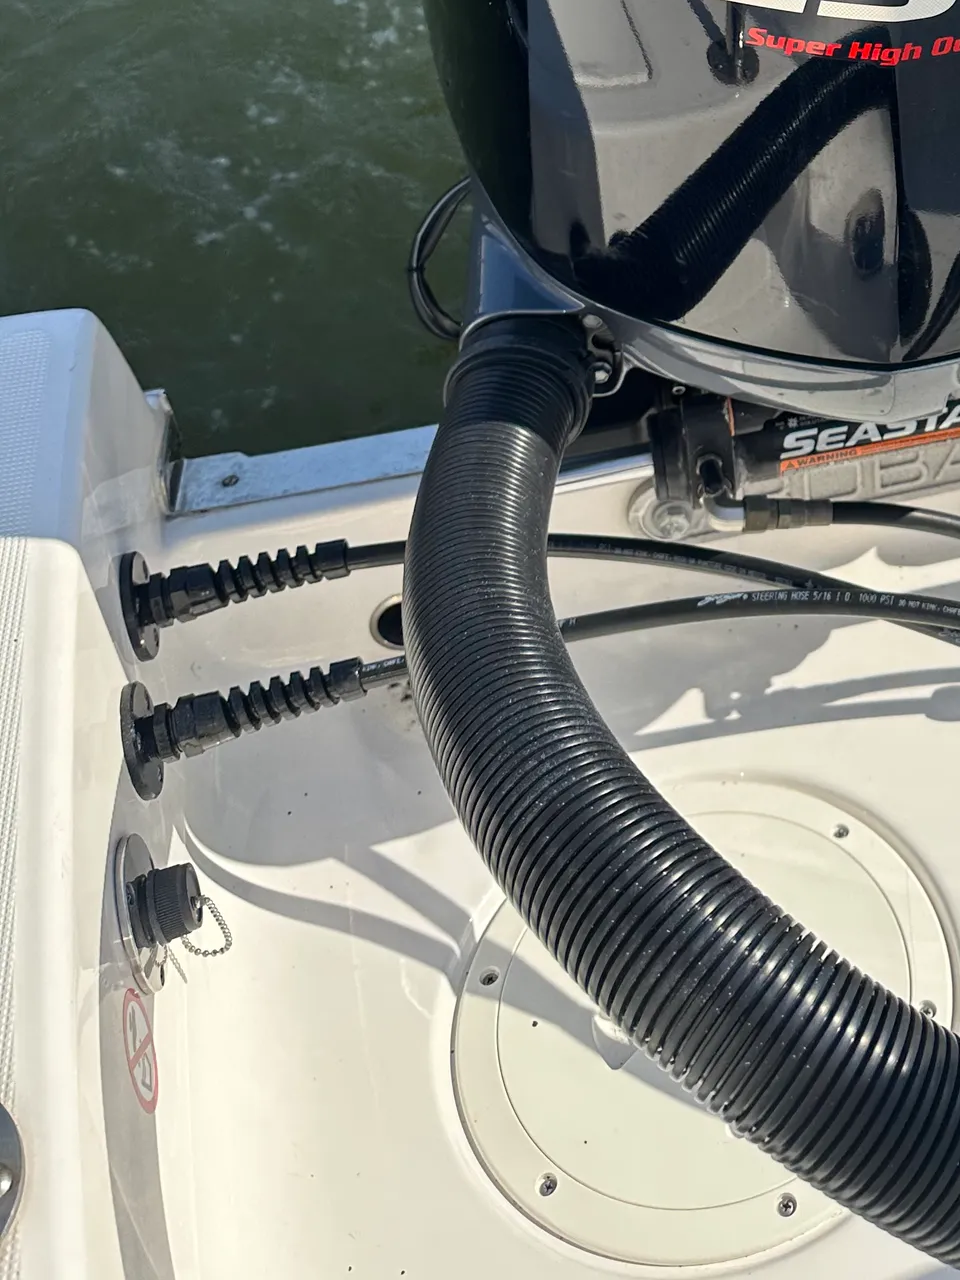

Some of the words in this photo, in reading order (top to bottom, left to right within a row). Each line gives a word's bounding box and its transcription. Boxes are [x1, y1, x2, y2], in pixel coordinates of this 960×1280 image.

[745, 27, 840, 57] Super
[847, 41, 921, 67] High
[798, 449, 857, 466] WARNING
[752, 591, 788, 602] STEERING
[791, 590, 809, 601] HOSE
[813, 591, 832, 601] 5/16
[859, 592, 877, 604] 1000
[880, 594, 895, 606] PSI
